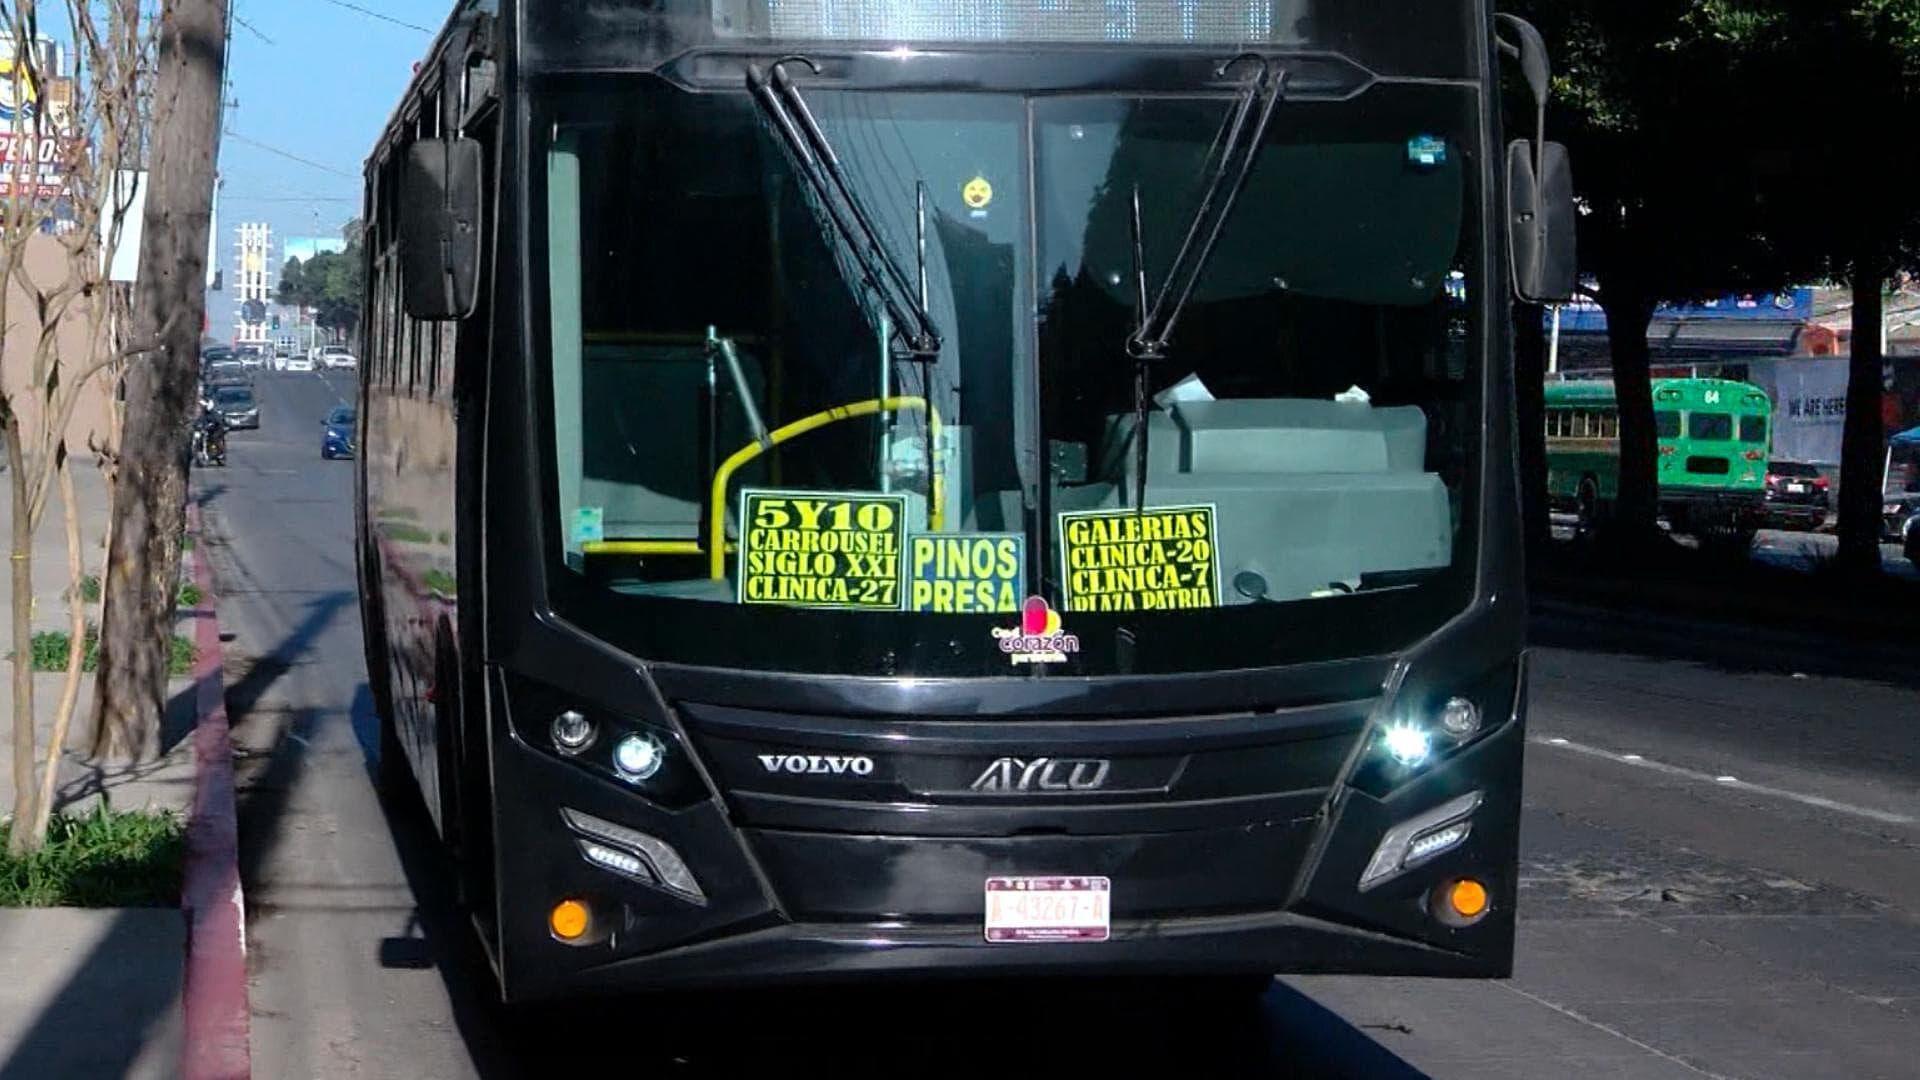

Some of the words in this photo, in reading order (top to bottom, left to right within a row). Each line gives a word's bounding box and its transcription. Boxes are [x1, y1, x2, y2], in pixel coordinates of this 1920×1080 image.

[750, 529, 898, 554] CARROUSEL
[1068, 512, 1206, 545] GALERIAS
[748, 551, 836, 576] SIGLO
[845, 553, 897, 578] XXI
[914, 539, 1018, 579] PINOS
[1070, 540, 1211, 569] CLINICA-20
[747, 576, 897, 604] CLINICA-27
[1072, 563, 1210, 595] CLINICA-7
[912, 580, 1018, 612] PRESA
[1073, 591, 1135, 612] PLAZA
[1142, 587, 1212, 610] PATRIA
[999, 631, 1079, 652] corazón
[758, 755, 874, 775] VOLVO
